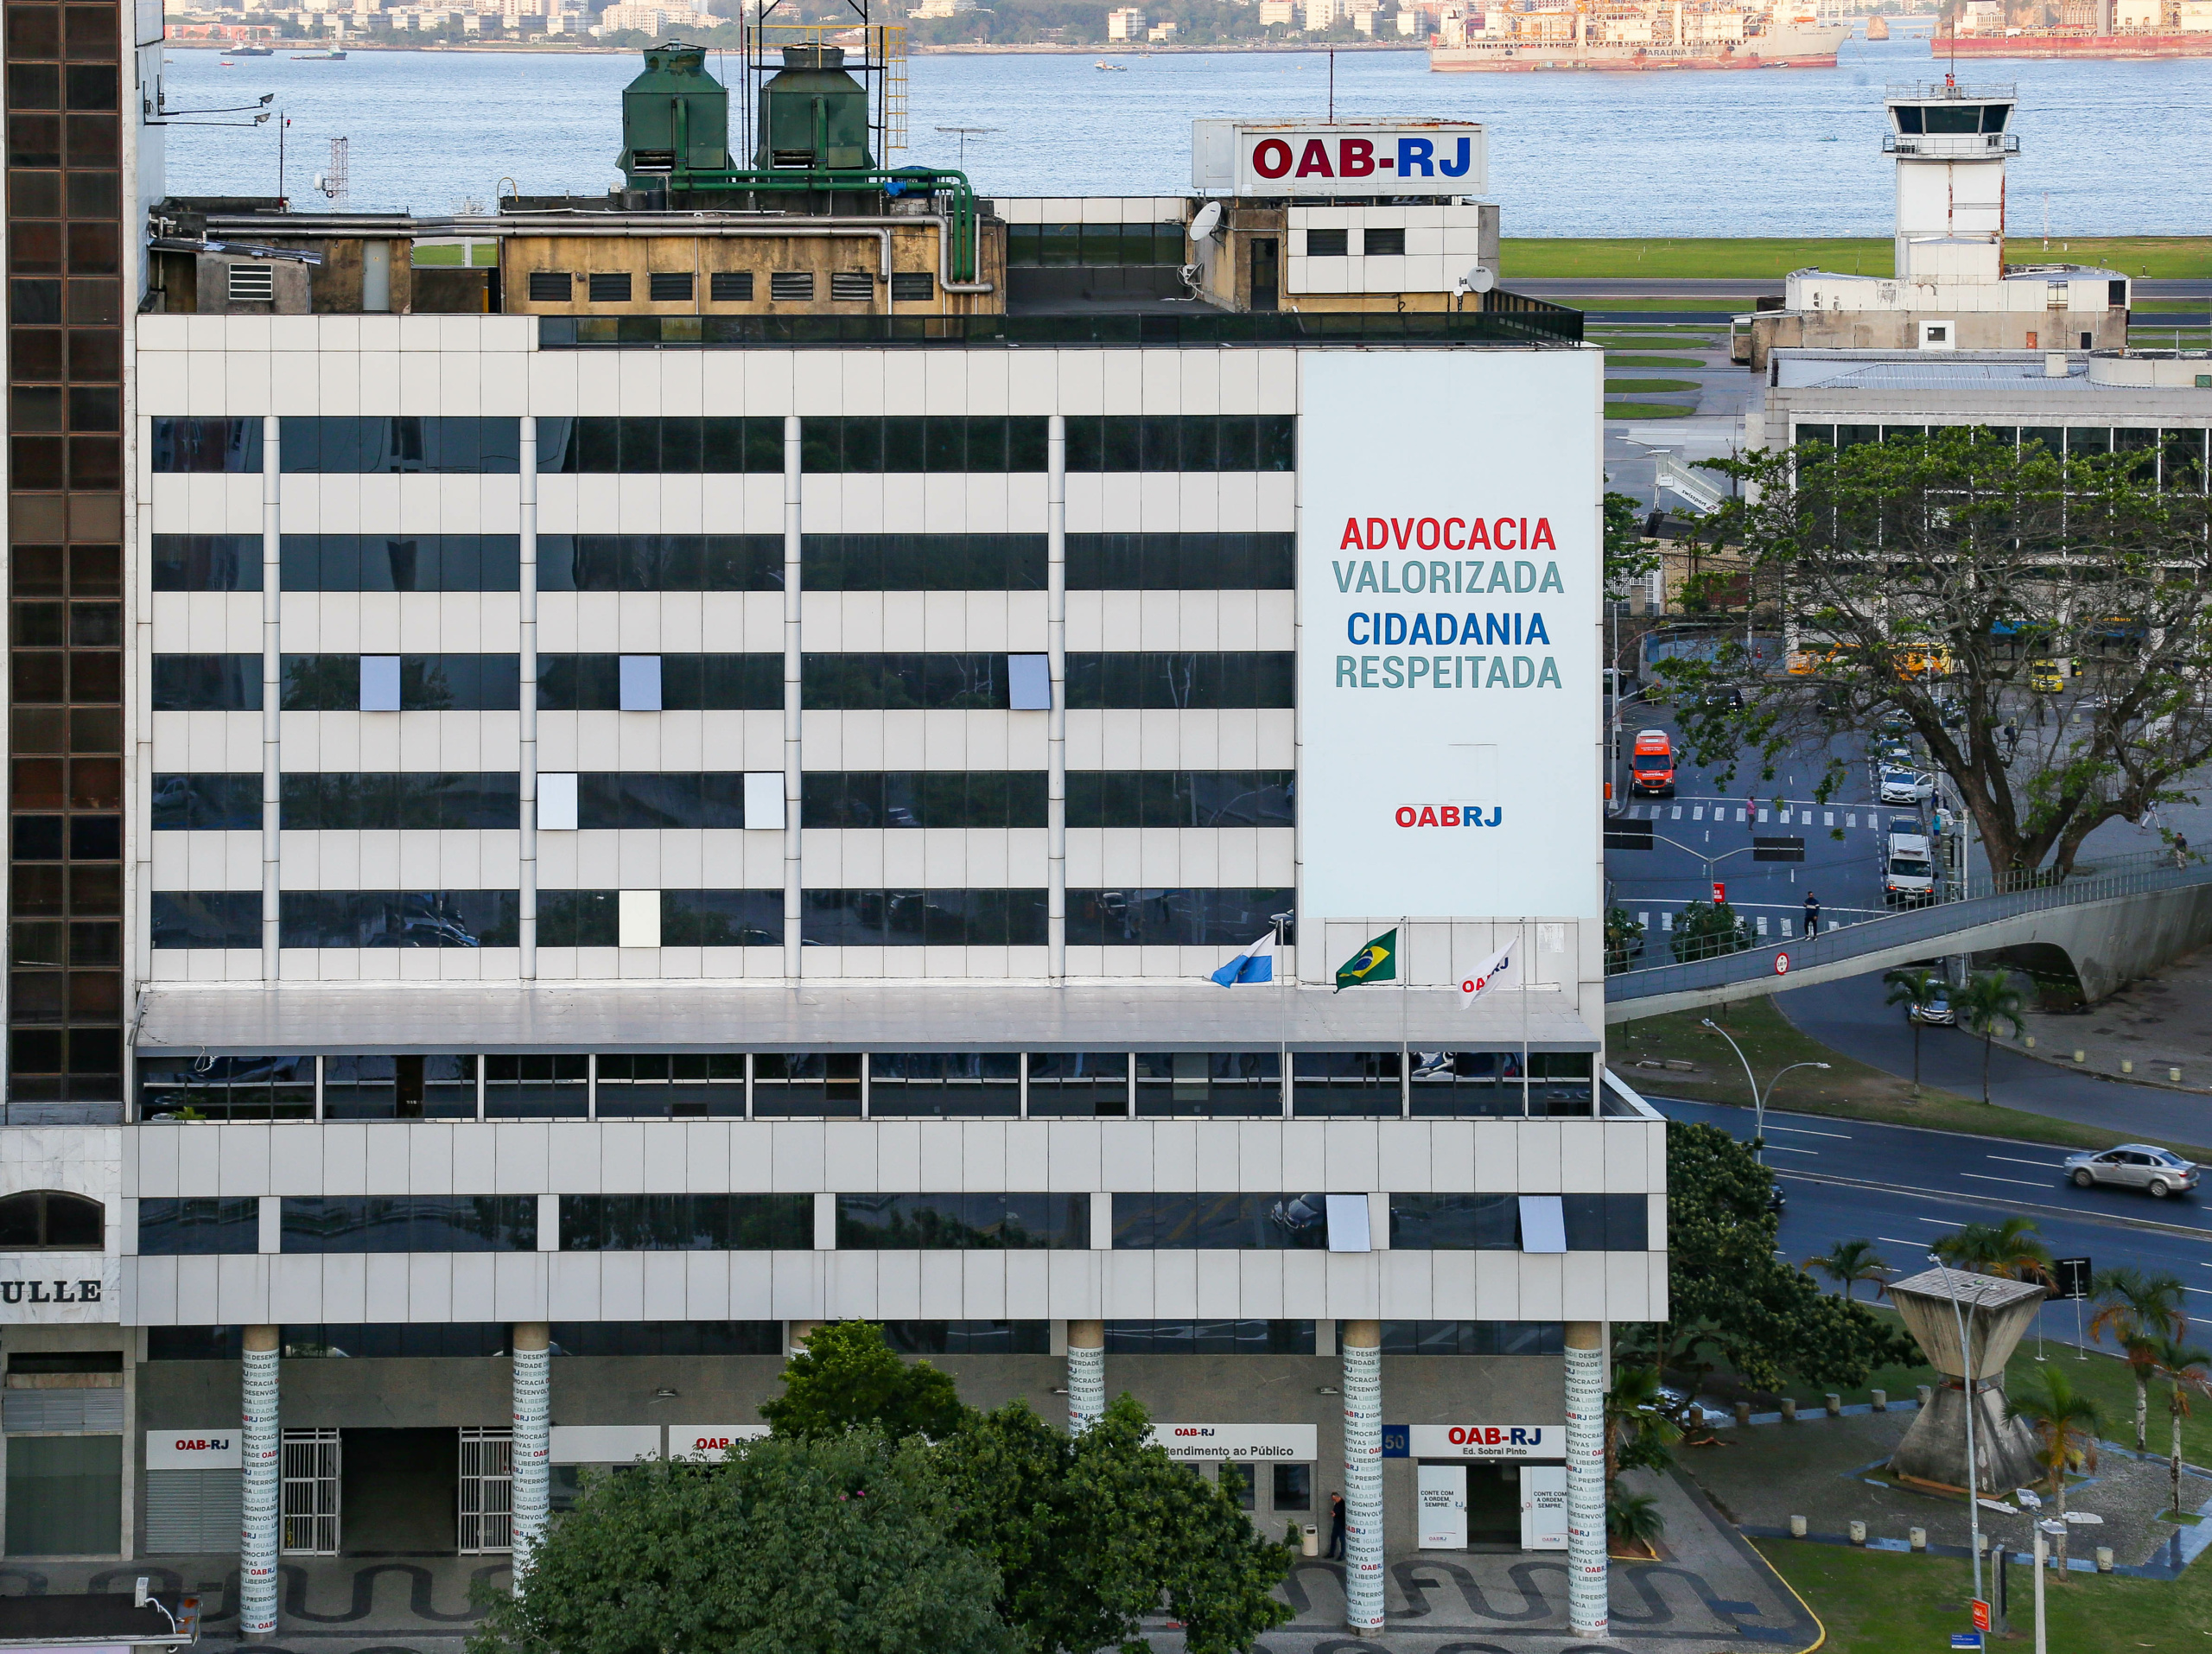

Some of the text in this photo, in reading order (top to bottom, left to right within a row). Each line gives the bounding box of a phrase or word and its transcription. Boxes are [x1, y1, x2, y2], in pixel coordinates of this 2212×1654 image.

[1252, 137, 1471, 179] OAB-RJ
[1339, 517, 1556, 550] ADVOCACIA
[1332, 560, 1564, 594] VALORIZADA
[1347, 612, 1550, 646] CIDADANIA
[1336, 655, 1562, 690] RESPEITADA
[1395, 806, 1503, 828] OABRJ
[1462, 957, 1509, 993] OAJ
[0, 1281, 101, 1303] ULLE
[175, 1440, 229, 1450] OAB-RJ
[696, 1438, 754, 1449] OAB-
[1385, 1435, 1404, 1449] 50
[1448, 1428, 1541, 1445] OAB-RJ
[1166, 1446, 1230, 1456] tendimento
[1251, 1445, 1294, 1456] Público
